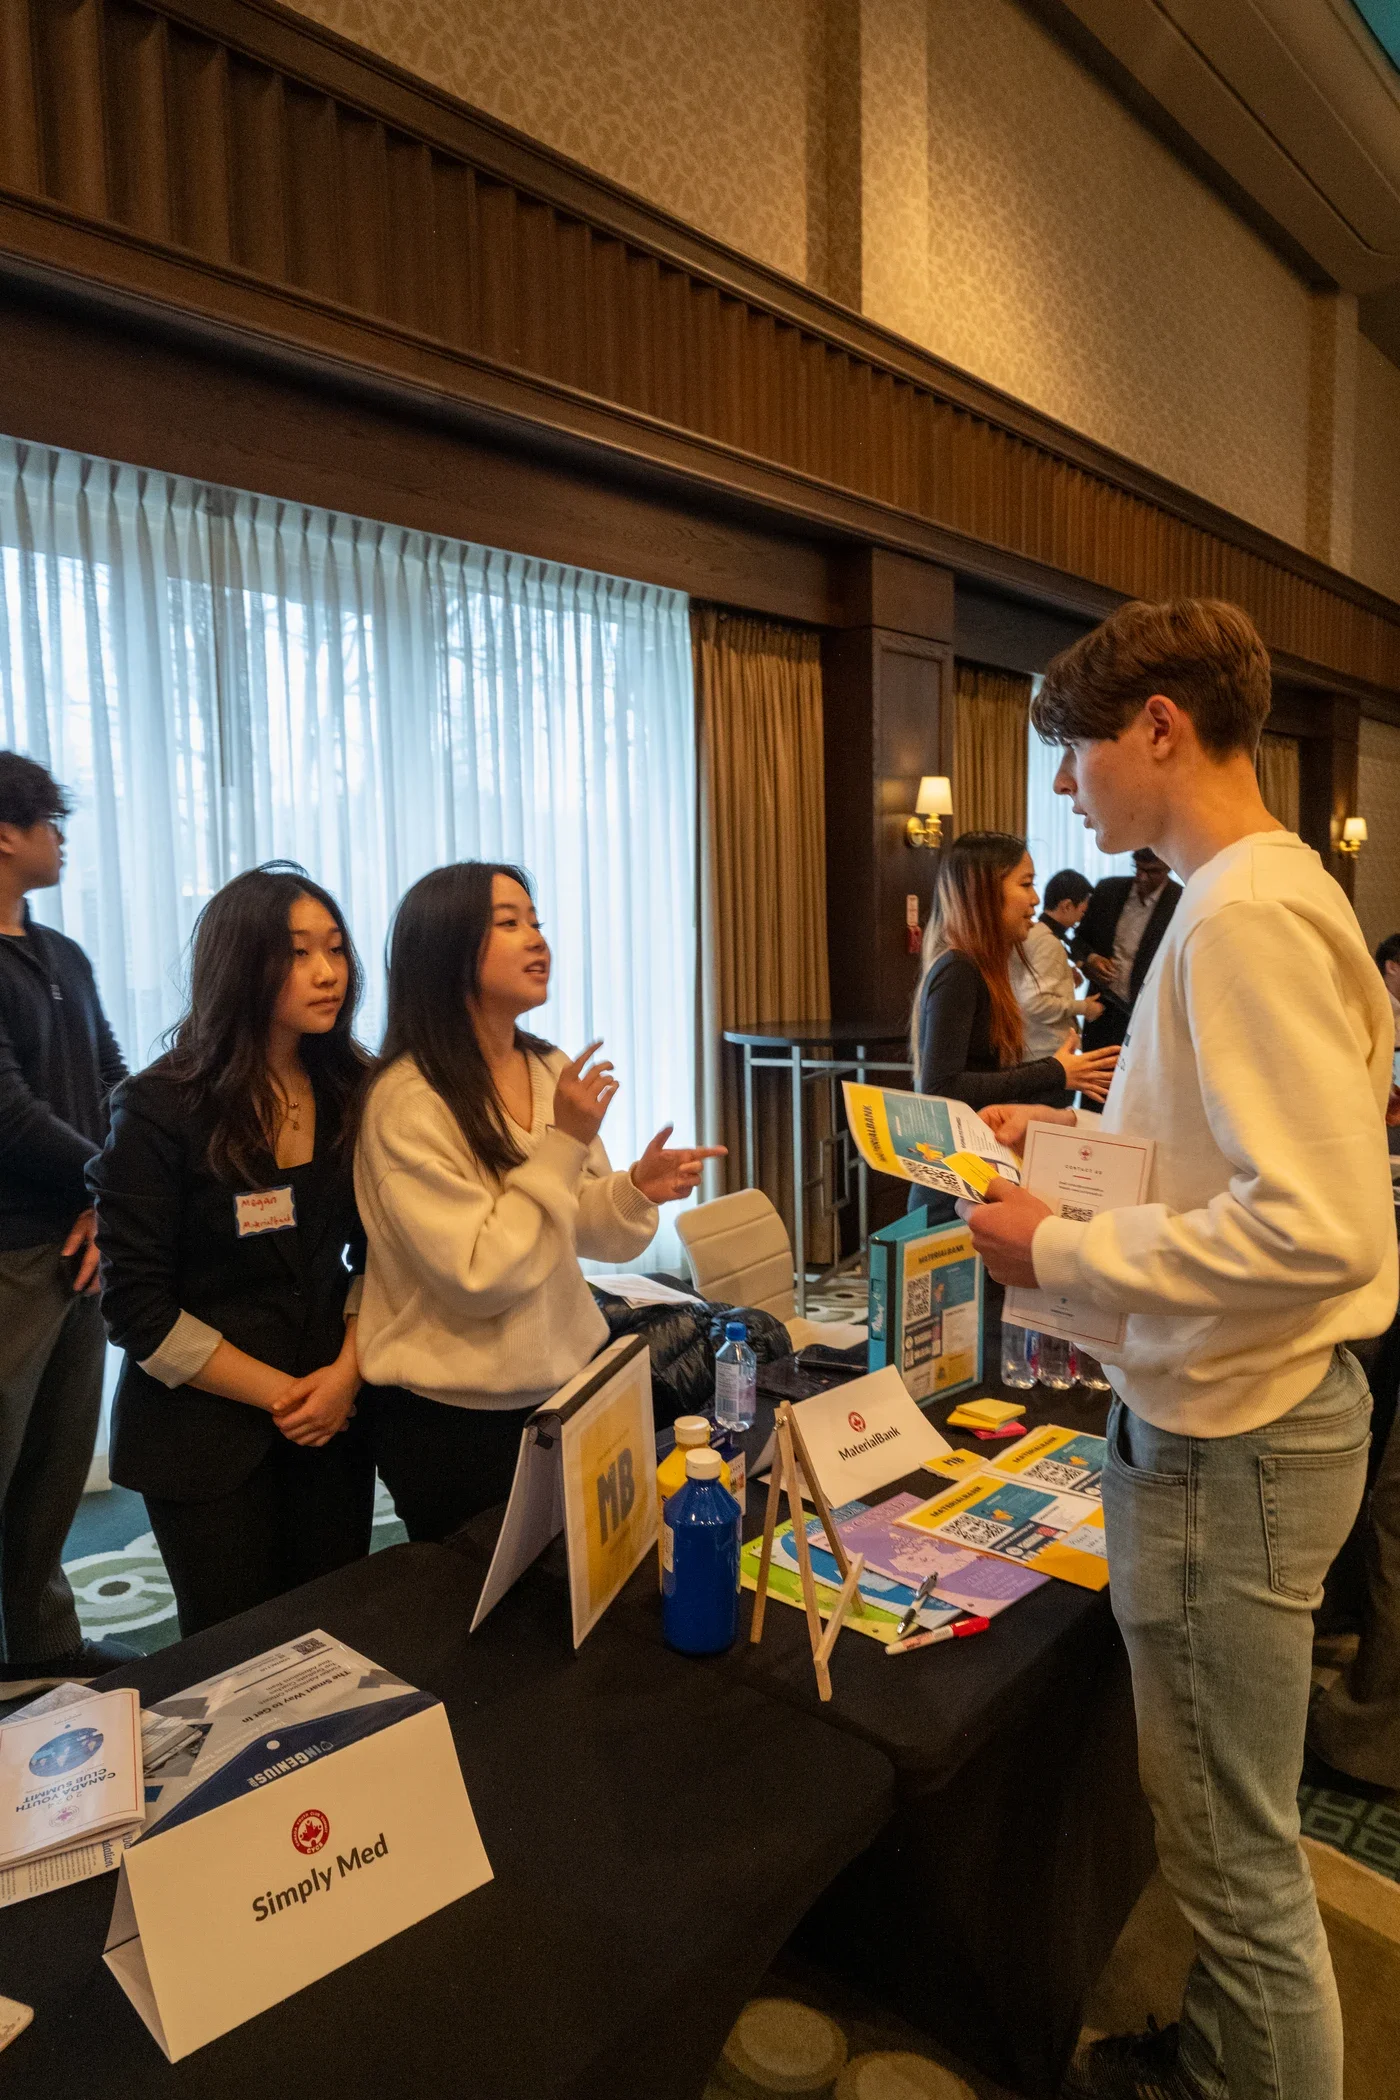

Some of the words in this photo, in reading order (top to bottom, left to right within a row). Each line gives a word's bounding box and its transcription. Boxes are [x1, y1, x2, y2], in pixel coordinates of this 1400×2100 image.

[838, 1425, 901, 1461] MaterialBank
[942, 1456, 966, 1467] MB
[596, 1447, 636, 1547] MB
[930, 1485, 984, 1518] MATERIALBANK
[332, 1670, 352, 1680] The
[305, 1679, 333, 1693] Smart
[284, 1692, 306, 1703] Way
[253, 1707, 272, 1718] Get
[75, 1768, 107, 1783] CLUB
[254, 1744, 322, 1786] INGENIUS
[23, 1780, 73, 1804] SUMMIT
[62, 1772, 116, 1795] CANADA
[15, 1793, 60, 1813] YOUTH
[251, 1865, 333, 1922] Simply
[336, 1832, 390, 1877] Med
